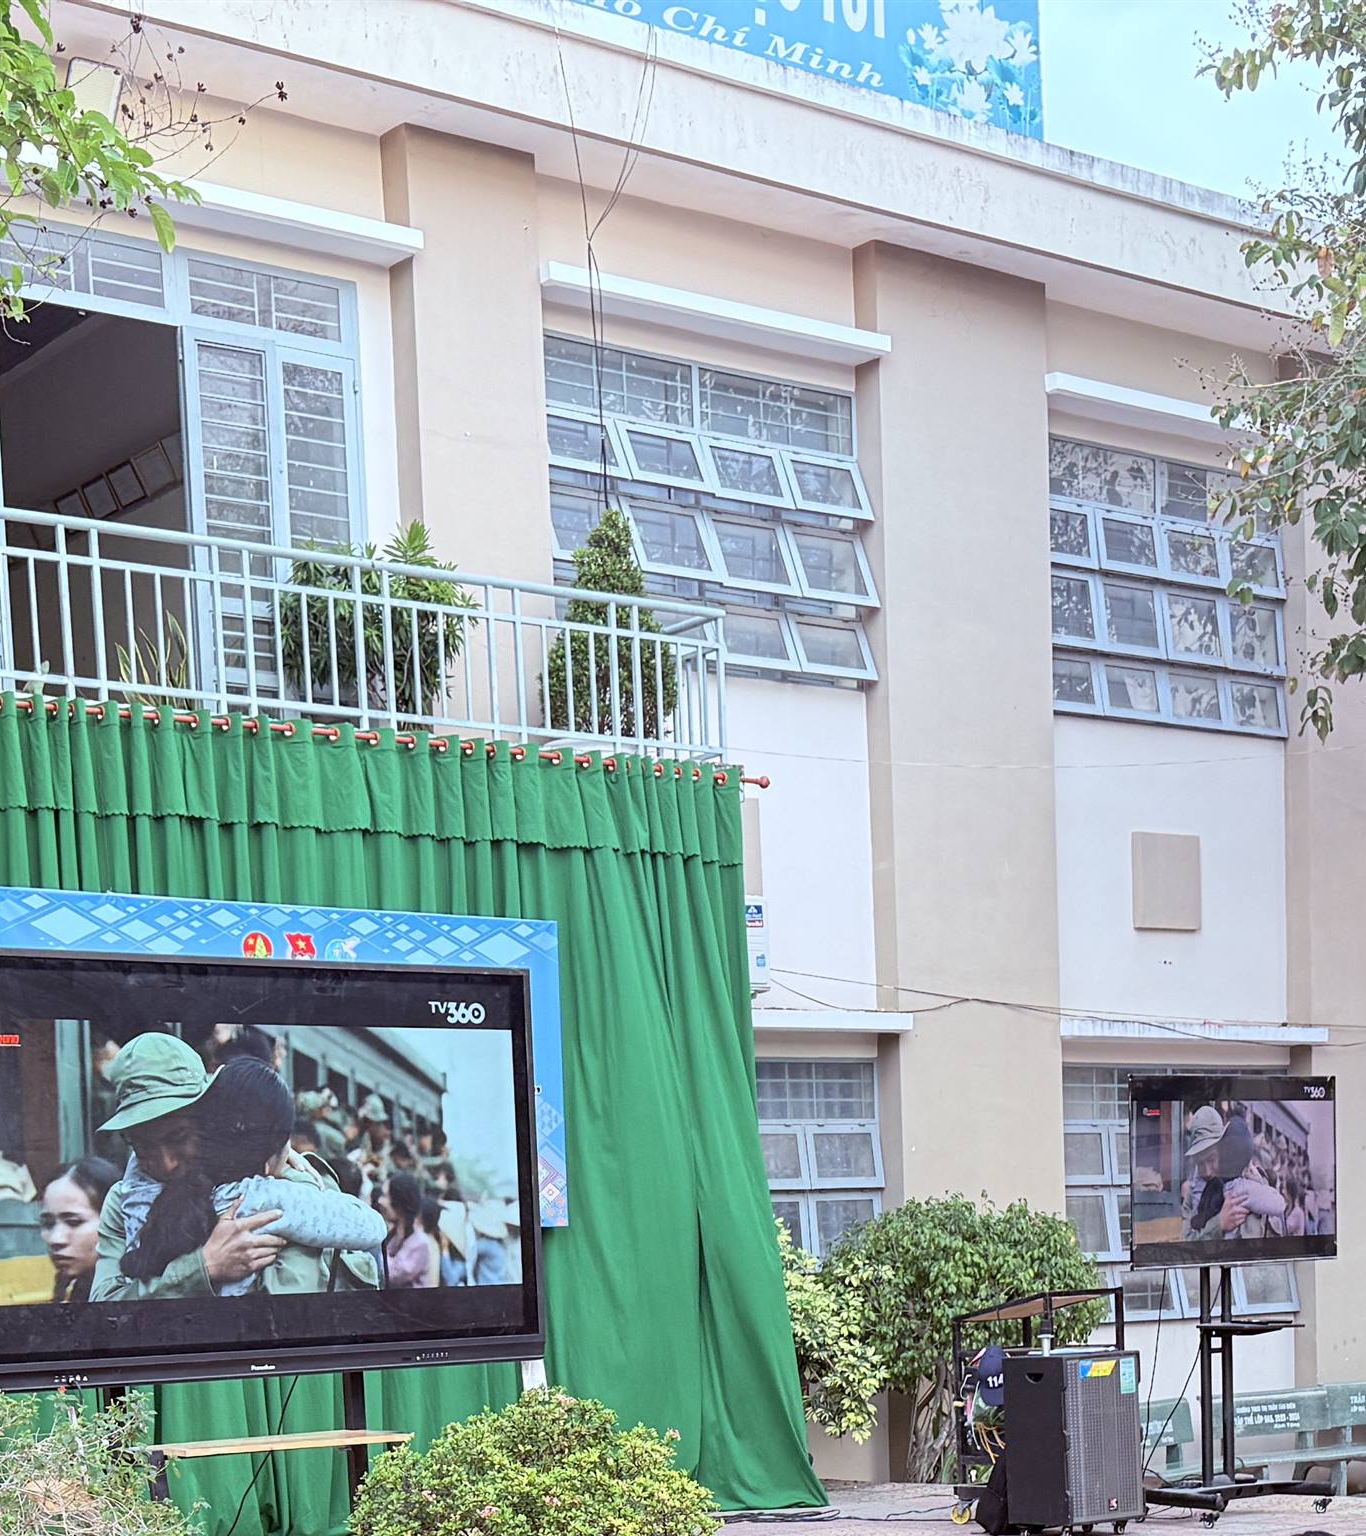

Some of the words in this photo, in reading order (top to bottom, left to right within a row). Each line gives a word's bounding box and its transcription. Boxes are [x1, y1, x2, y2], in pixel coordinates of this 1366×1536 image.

[662, 6, 751, 48] Chí
[764, 32, 885, 88] Minh
[427, 1001, 486, 1025] TV360
